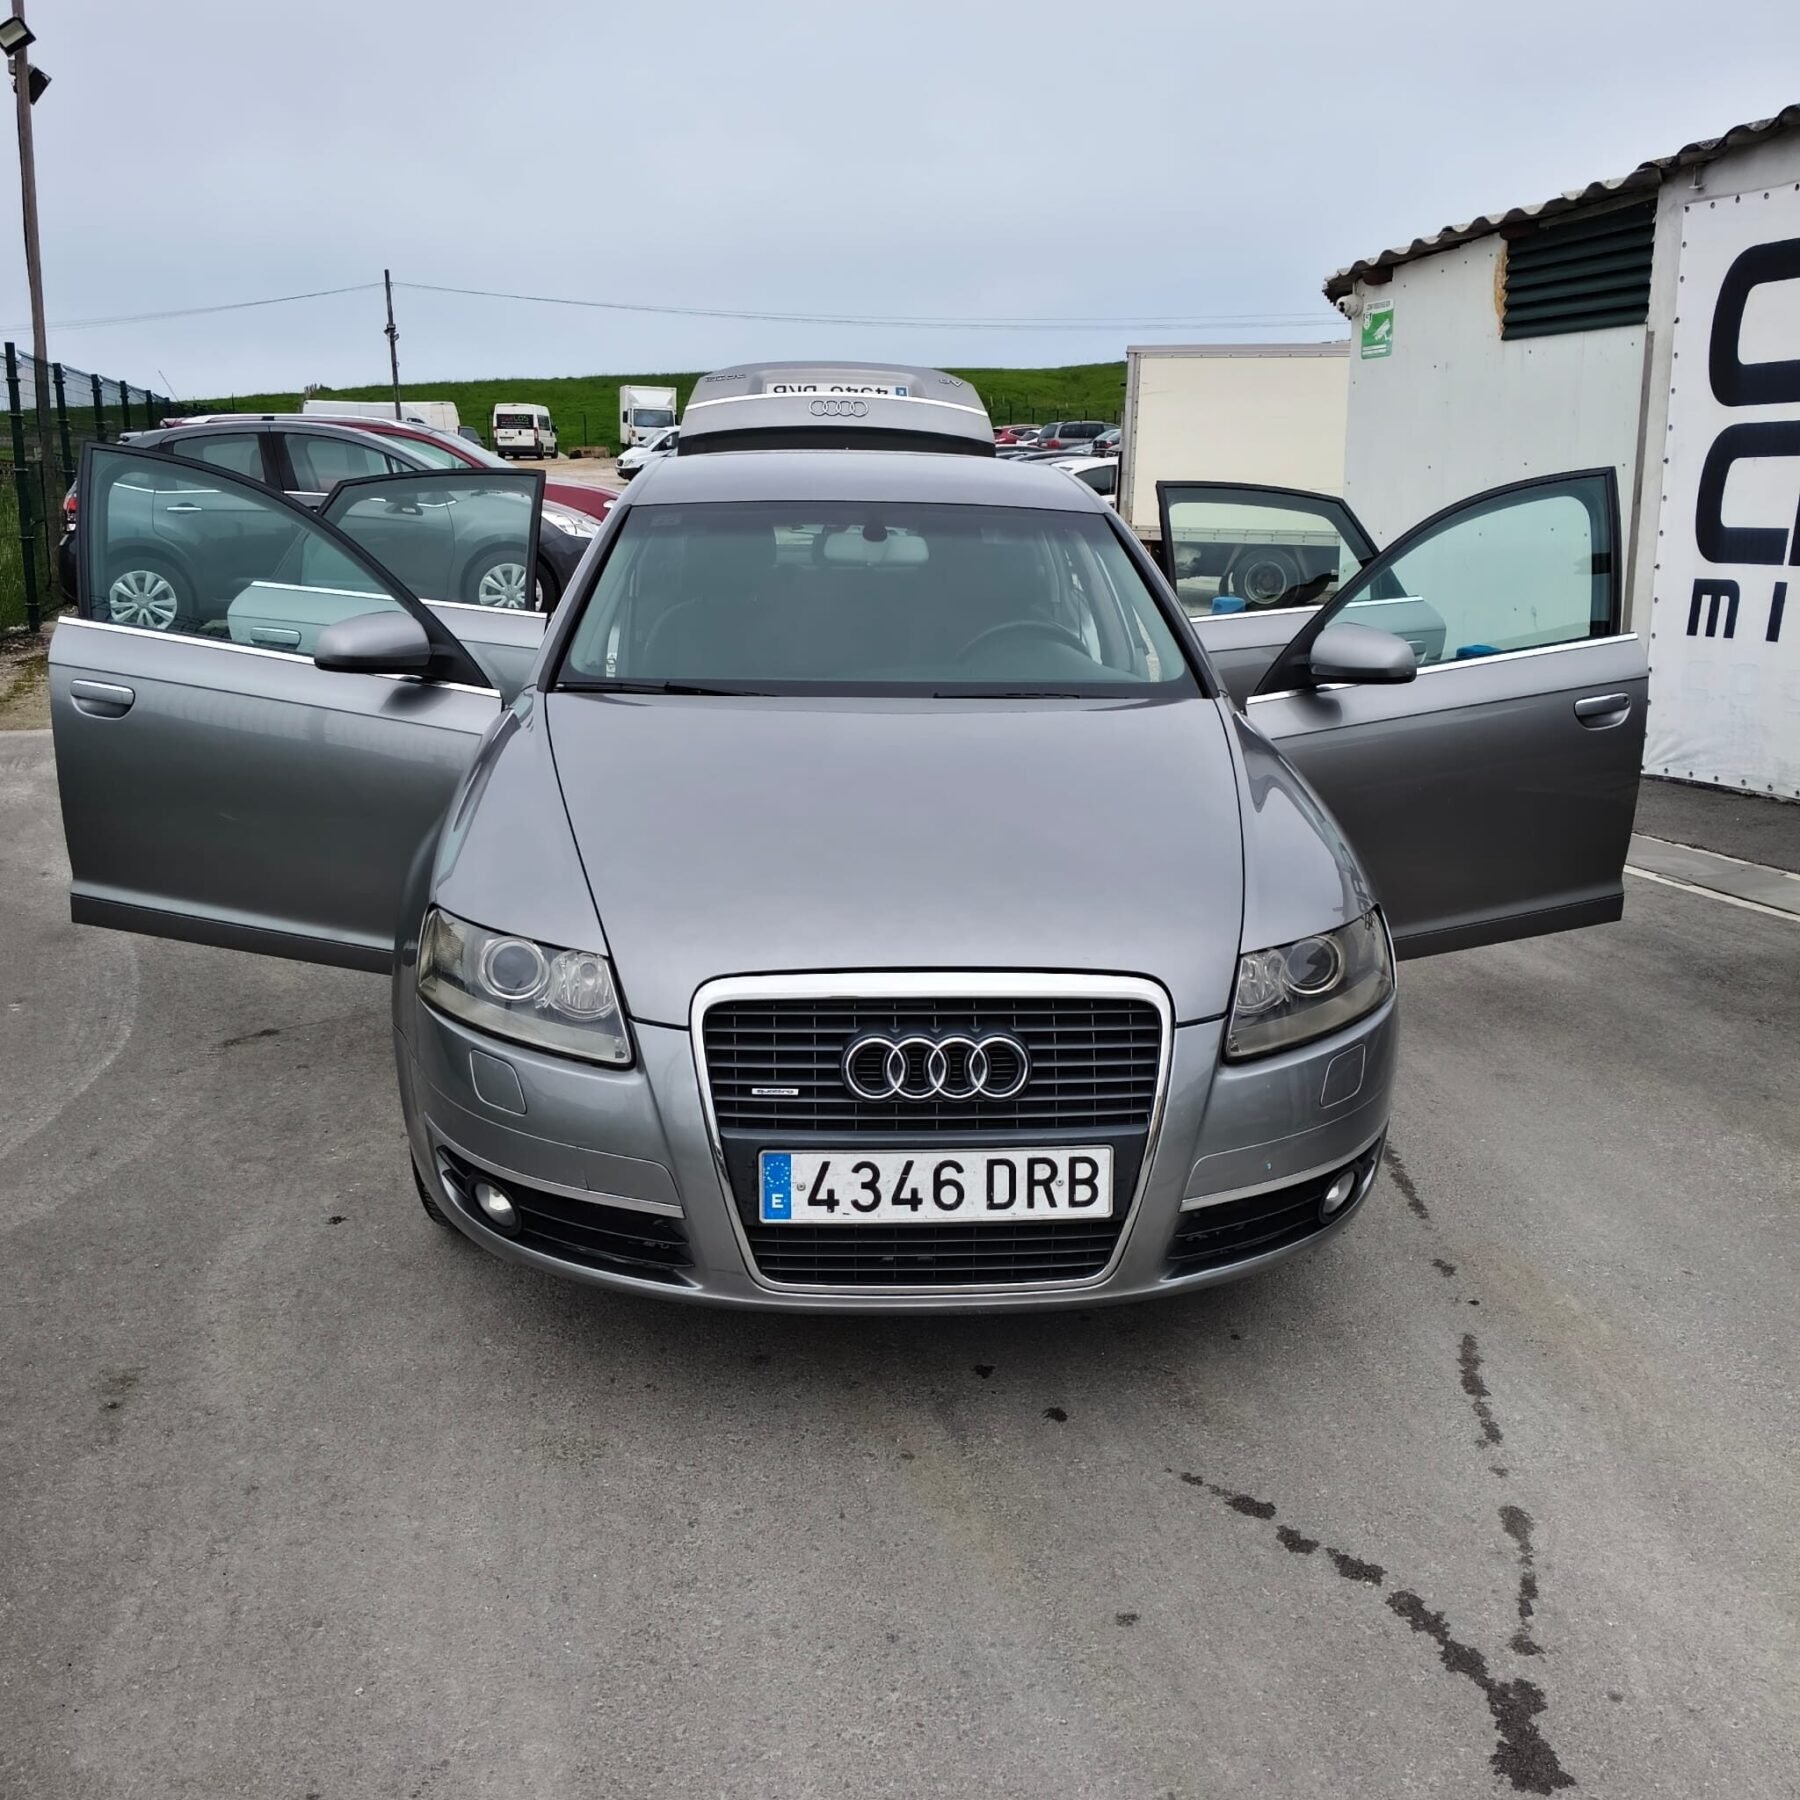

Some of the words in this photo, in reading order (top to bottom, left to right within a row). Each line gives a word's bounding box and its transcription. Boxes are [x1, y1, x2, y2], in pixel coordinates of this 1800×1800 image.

[772, 1193, 783, 1208] E
[807, 1160, 965, 1213] 4346
[986, 1156, 1099, 1210] DRB
